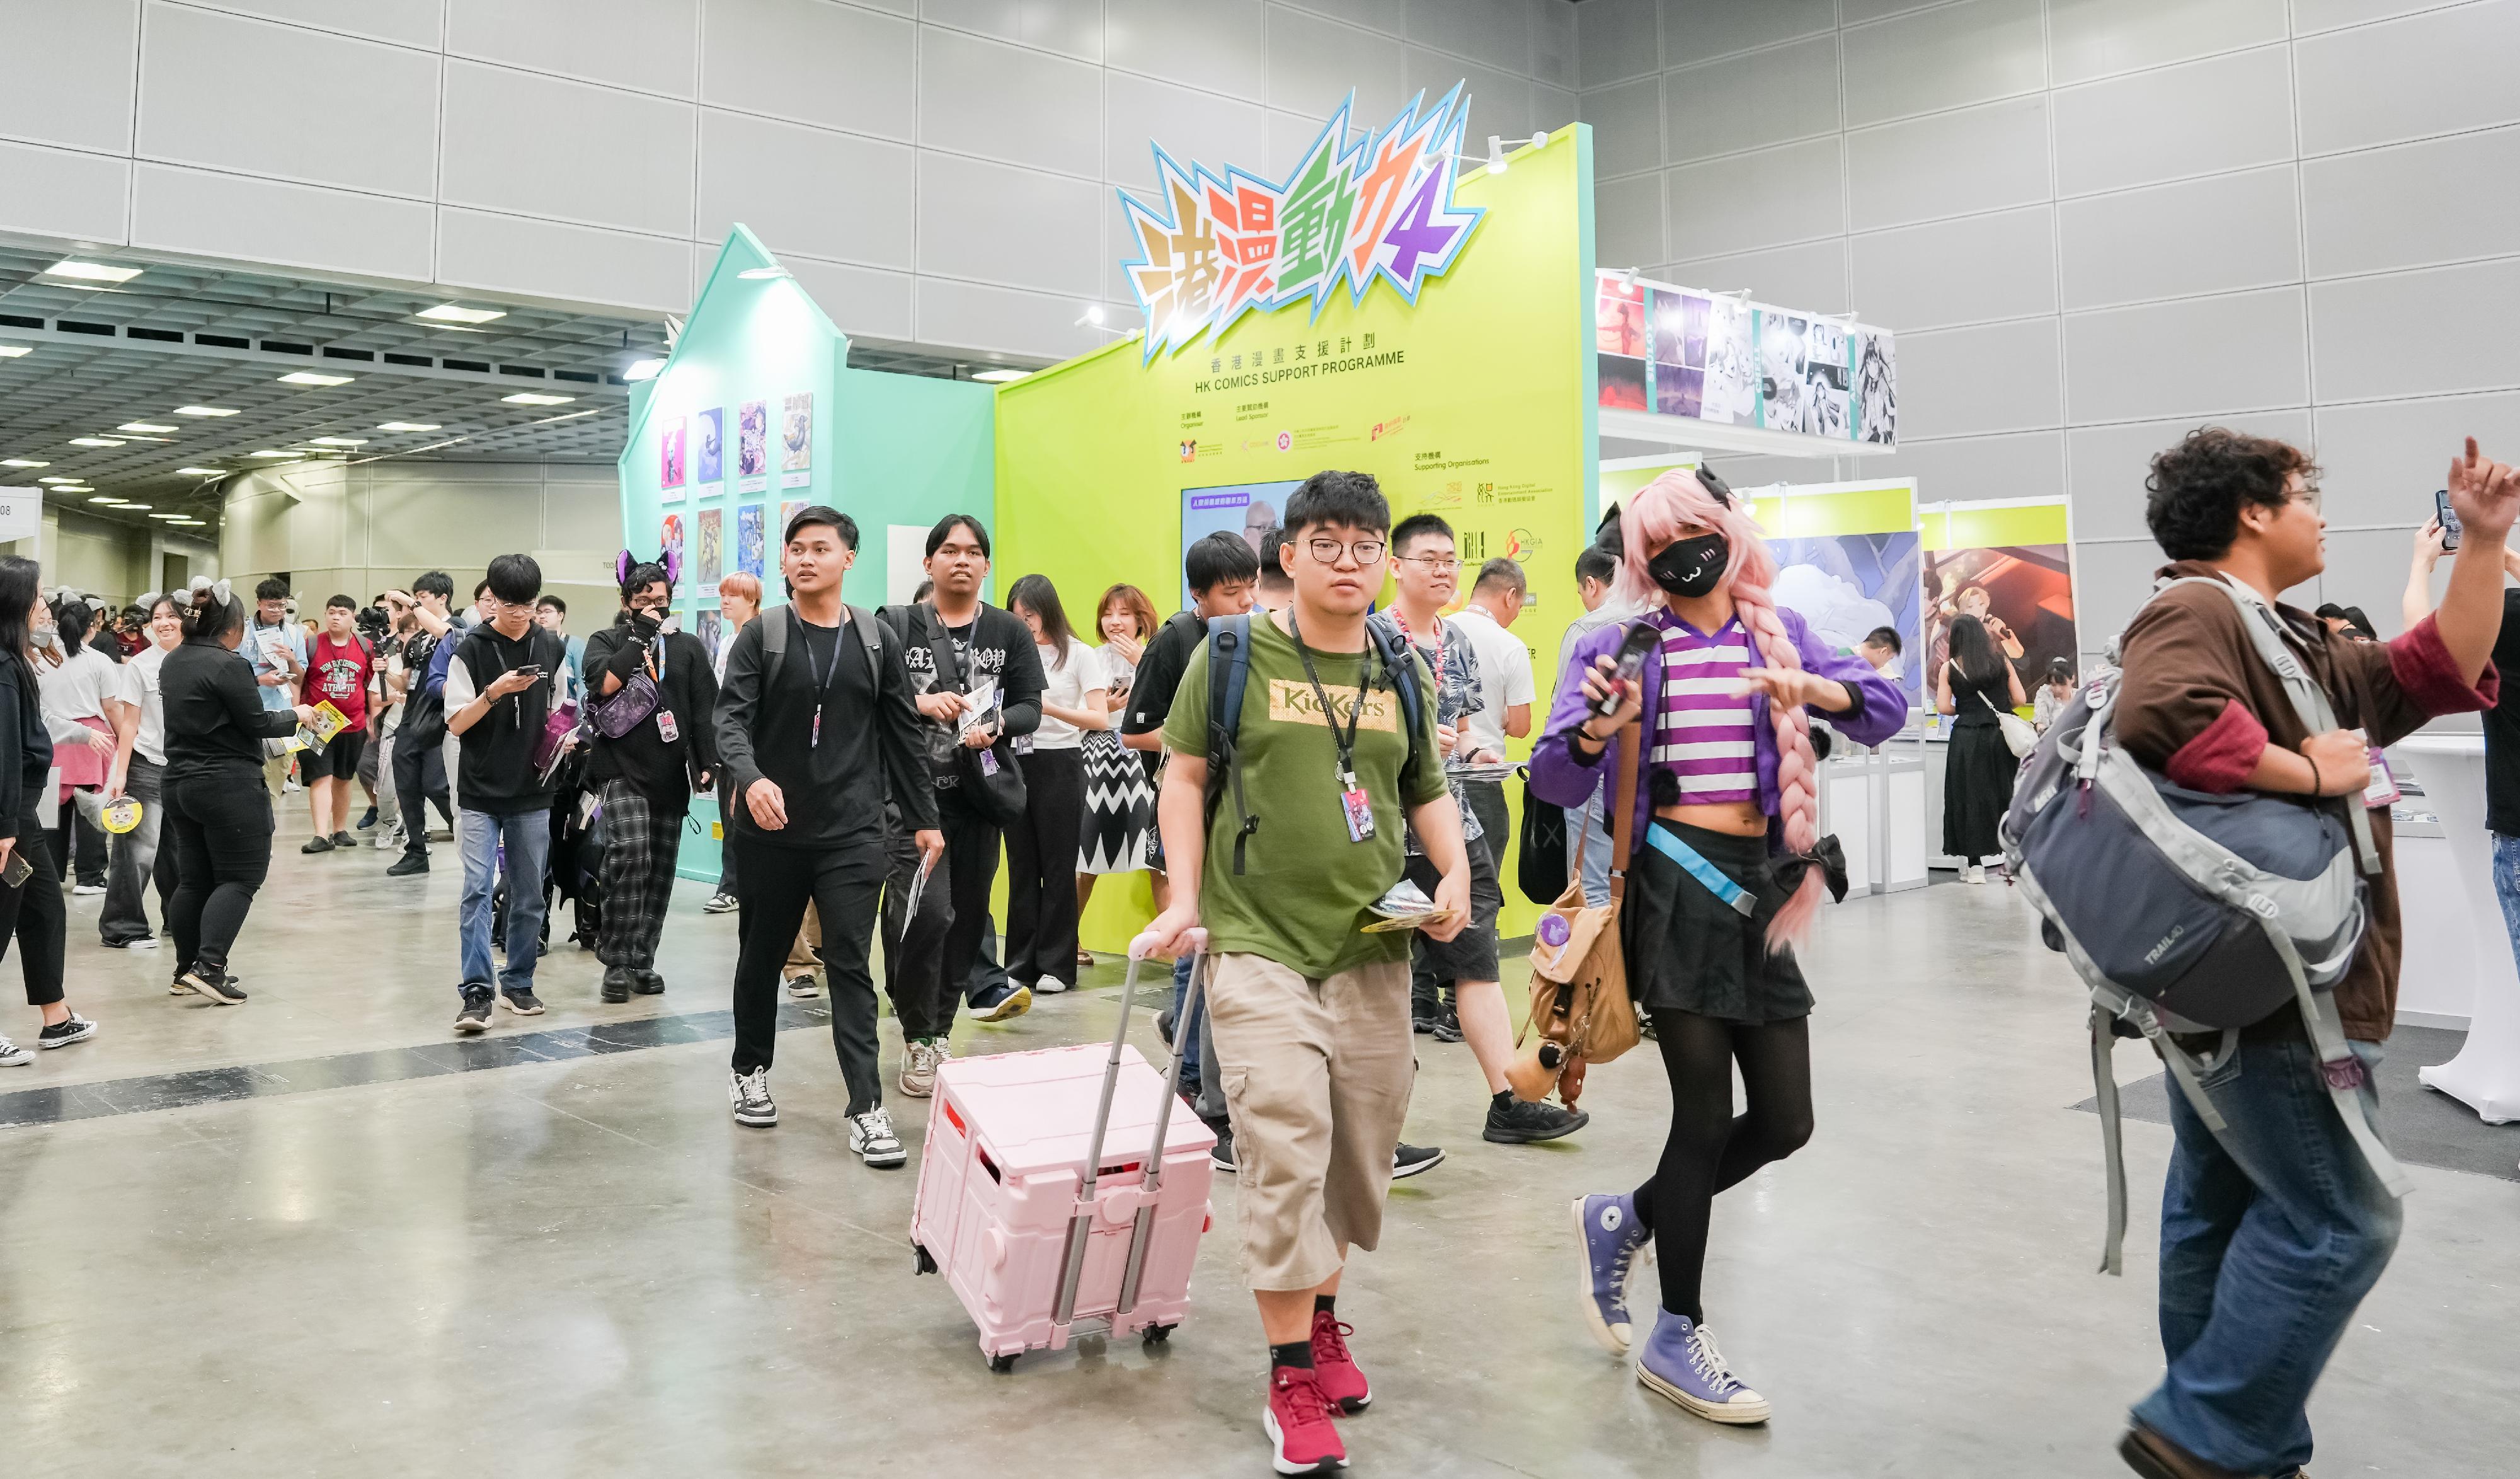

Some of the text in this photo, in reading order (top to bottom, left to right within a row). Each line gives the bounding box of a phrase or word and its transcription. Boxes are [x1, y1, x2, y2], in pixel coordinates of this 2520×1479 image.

[1137, 134, 1462, 335] 港漫動力4
[1195, 350, 1405, 394] HK COMICS SUPPORT PROGRAMME
[1210, 332, 1375, 373] 香港漫畫支援計劃
[1414, 458, 1489, 471] Supporting Organisations
[1521, 538, 1543, 546] HKGIA
